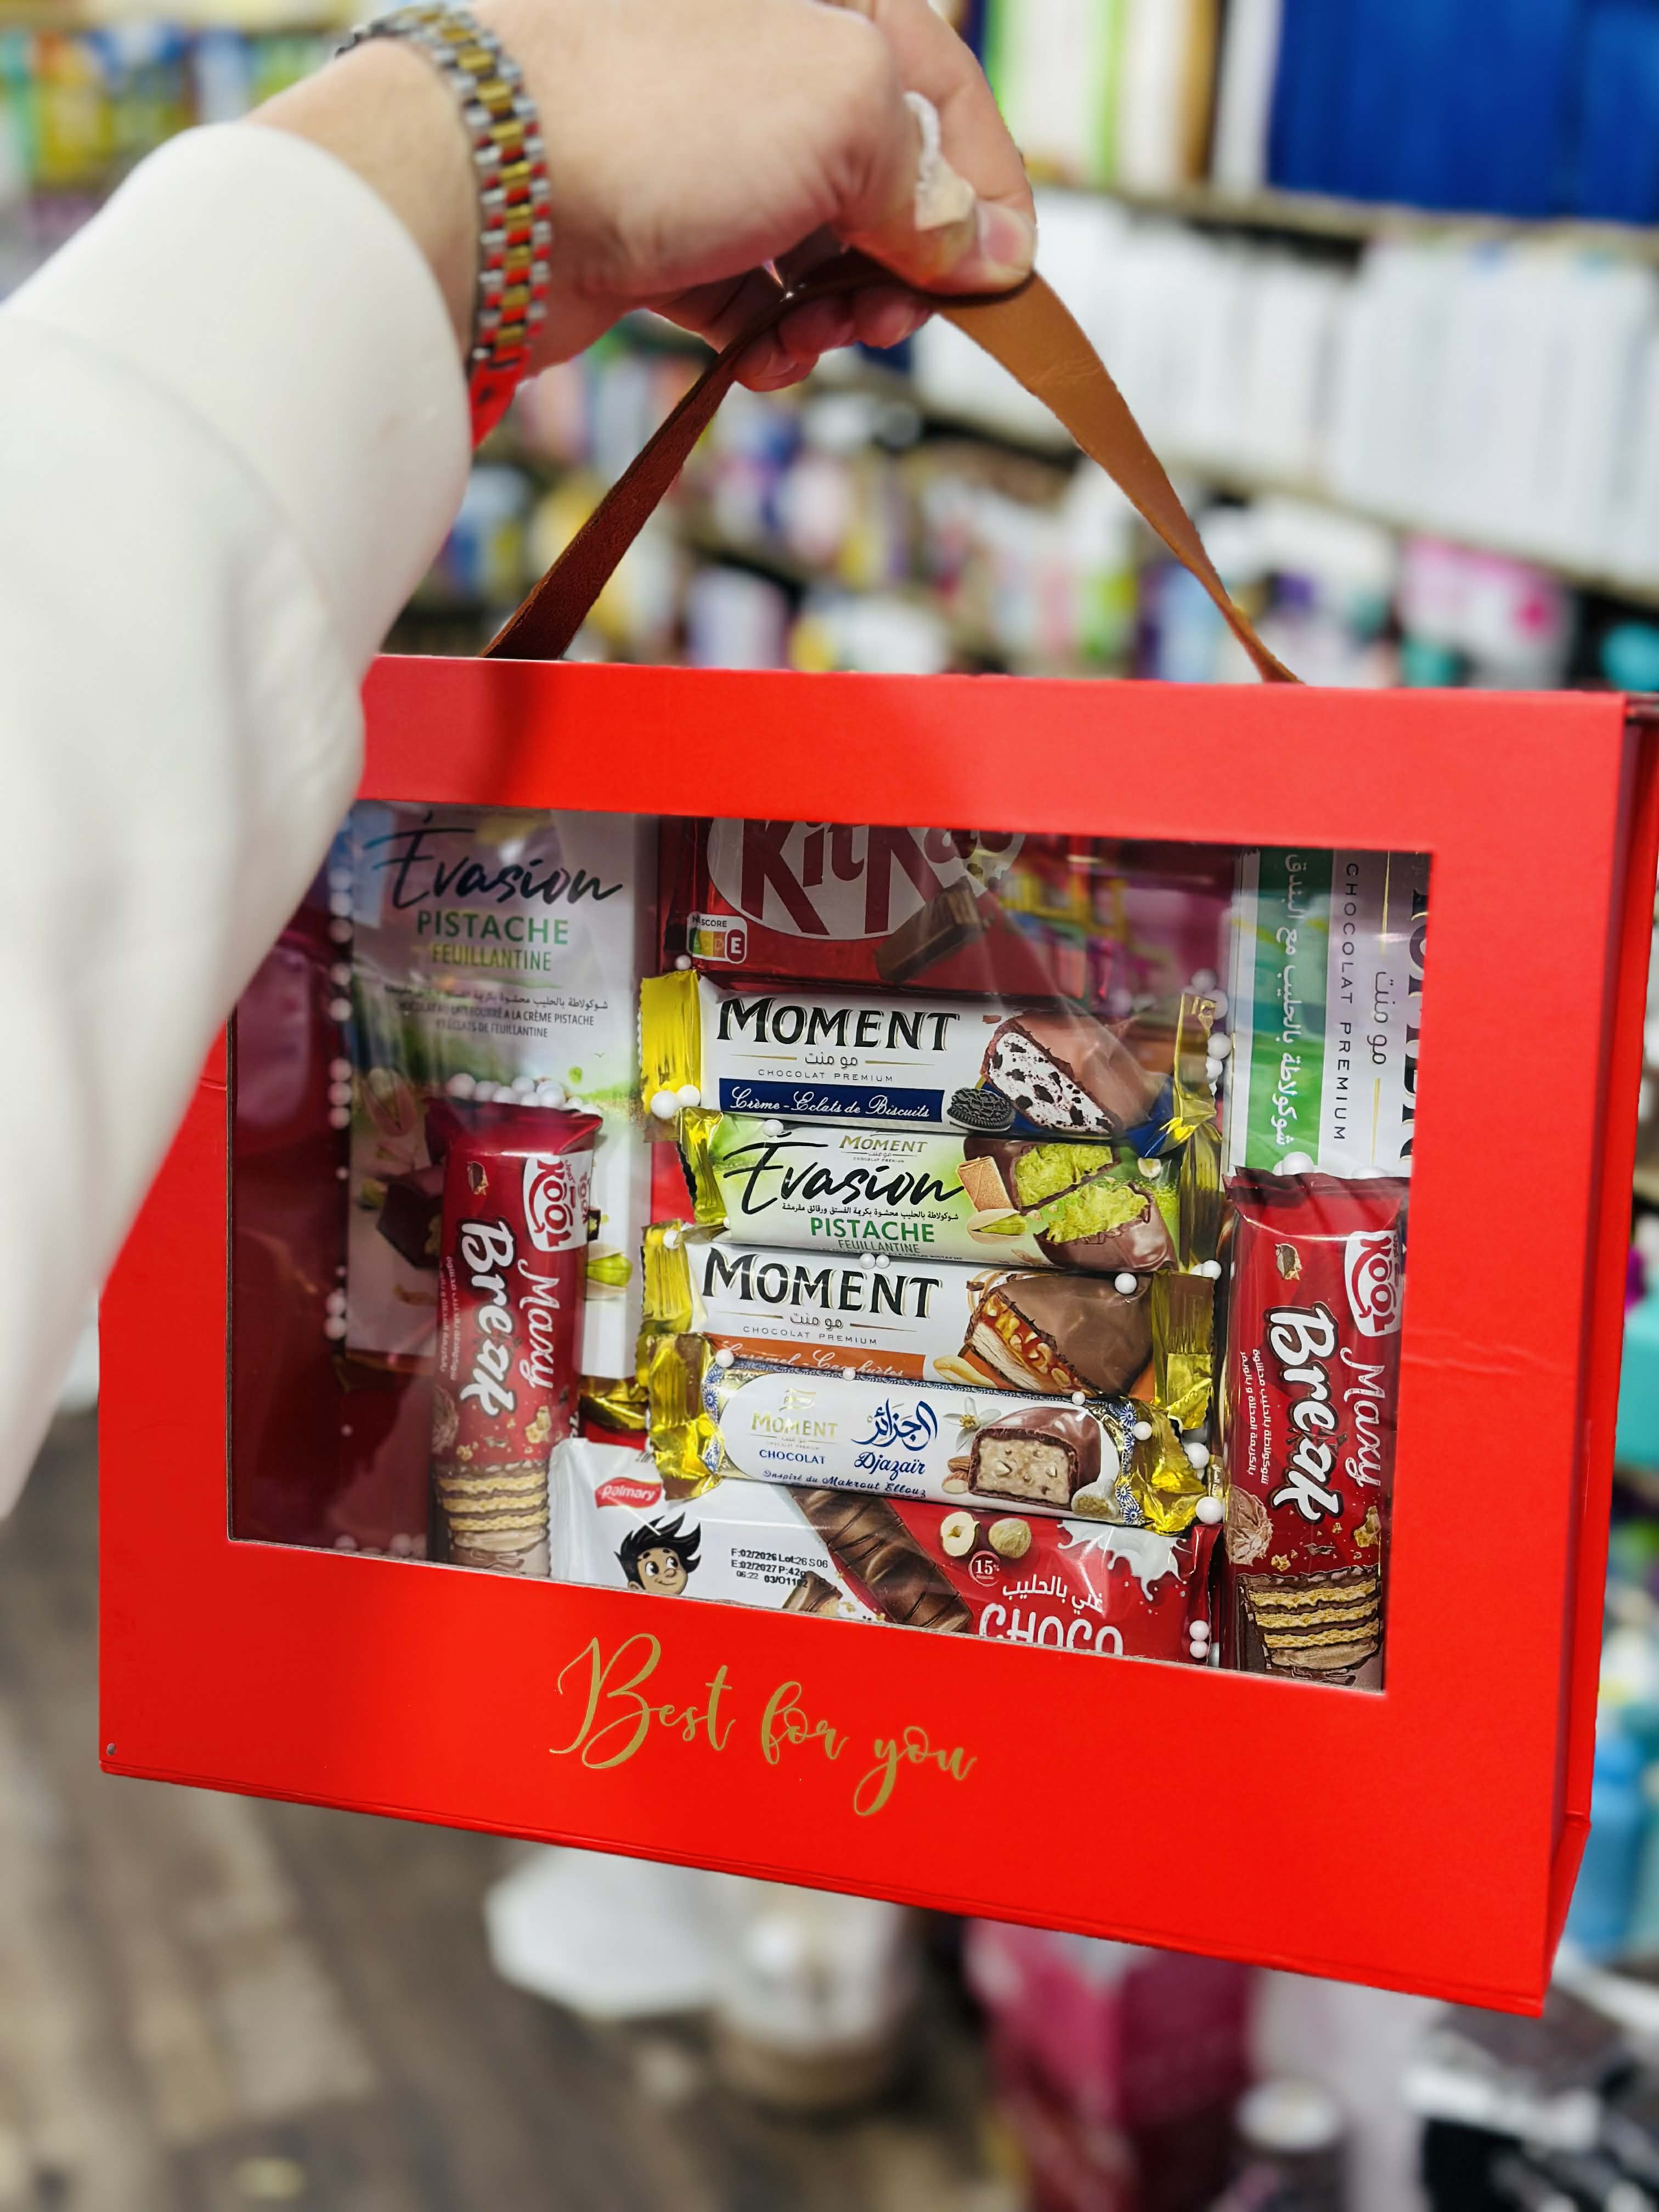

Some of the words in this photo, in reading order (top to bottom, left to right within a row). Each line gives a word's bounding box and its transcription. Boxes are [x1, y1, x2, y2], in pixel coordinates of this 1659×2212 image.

[1285, 854, 1307, 921] البندق
[417, 910, 569, 945] PISTACHE
[1276, 927, 1297, 955] مع
[1339, 863, 1359, 1004] CHOCOLAT
[432, 945, 551, 972] FEUILLANTINE
[731, 937, 742, 953] E
[511, 1011, 522, 1020] LA
[523, 1008, 552, 1023] CRÈME
[554, 1013, 594, 1025] PISTACHE
[1276, 965, 1302, 1045] بالحليب
[758, 1069, 825, 1079] CHOCOLAT
[834, 1073, 893, 1082] PREMIUM
[1334, 1022, 1352, 1141] PREMIUM
[844, 1103, 861, 1114] de
[865, 1094, 930, 1118] Biscuits
[1272, 1053, 1302, 1146] شوكولاطة
[839, 1135, 928, 1153] MOMENT
[830, 1206, 851, 1215] الفستق
[874, 1209, 899, 1217] محشوة
[901, 1210, 926, 1218] بالحليب
[927, 1211, 959, 1221] شوكولاطة
[811, 1217, 935, 1243] PISTACHE
[838, 1240, 921, 1254] FEUILLANTINE
[460, 1218, 517, 1418] Break
[517, 1259, 560, 1390] Maxy
[743, 1326, 810, 1339] CHOCOLAT
[820, 1334, 877, 1345] PREMIUM
[1260, 1389, 1272, 1427] بالحليب
[1270, 1306, 1341, 1522] Break
[1340, 1346, 1384, 1487] Maxy
[759, 1449, 826, 1464] CHOCOLAT
[854, 1451, 926, 1481] Djazaïr
[1246, 1432, 1259, 1475] بالكريمة
[600, 1483, 656, 1504] palmary
[731, 1548, 777, 1561] F:02/2026
[731, 1560, 777, 1573] E:02/2027
[1002, 1574, 1068, 1604] بالحليب
[549, 1633, 736, 1769] Best
[761, 1680, 850, 1765] for
[854, 1726, 977, 1816] you
